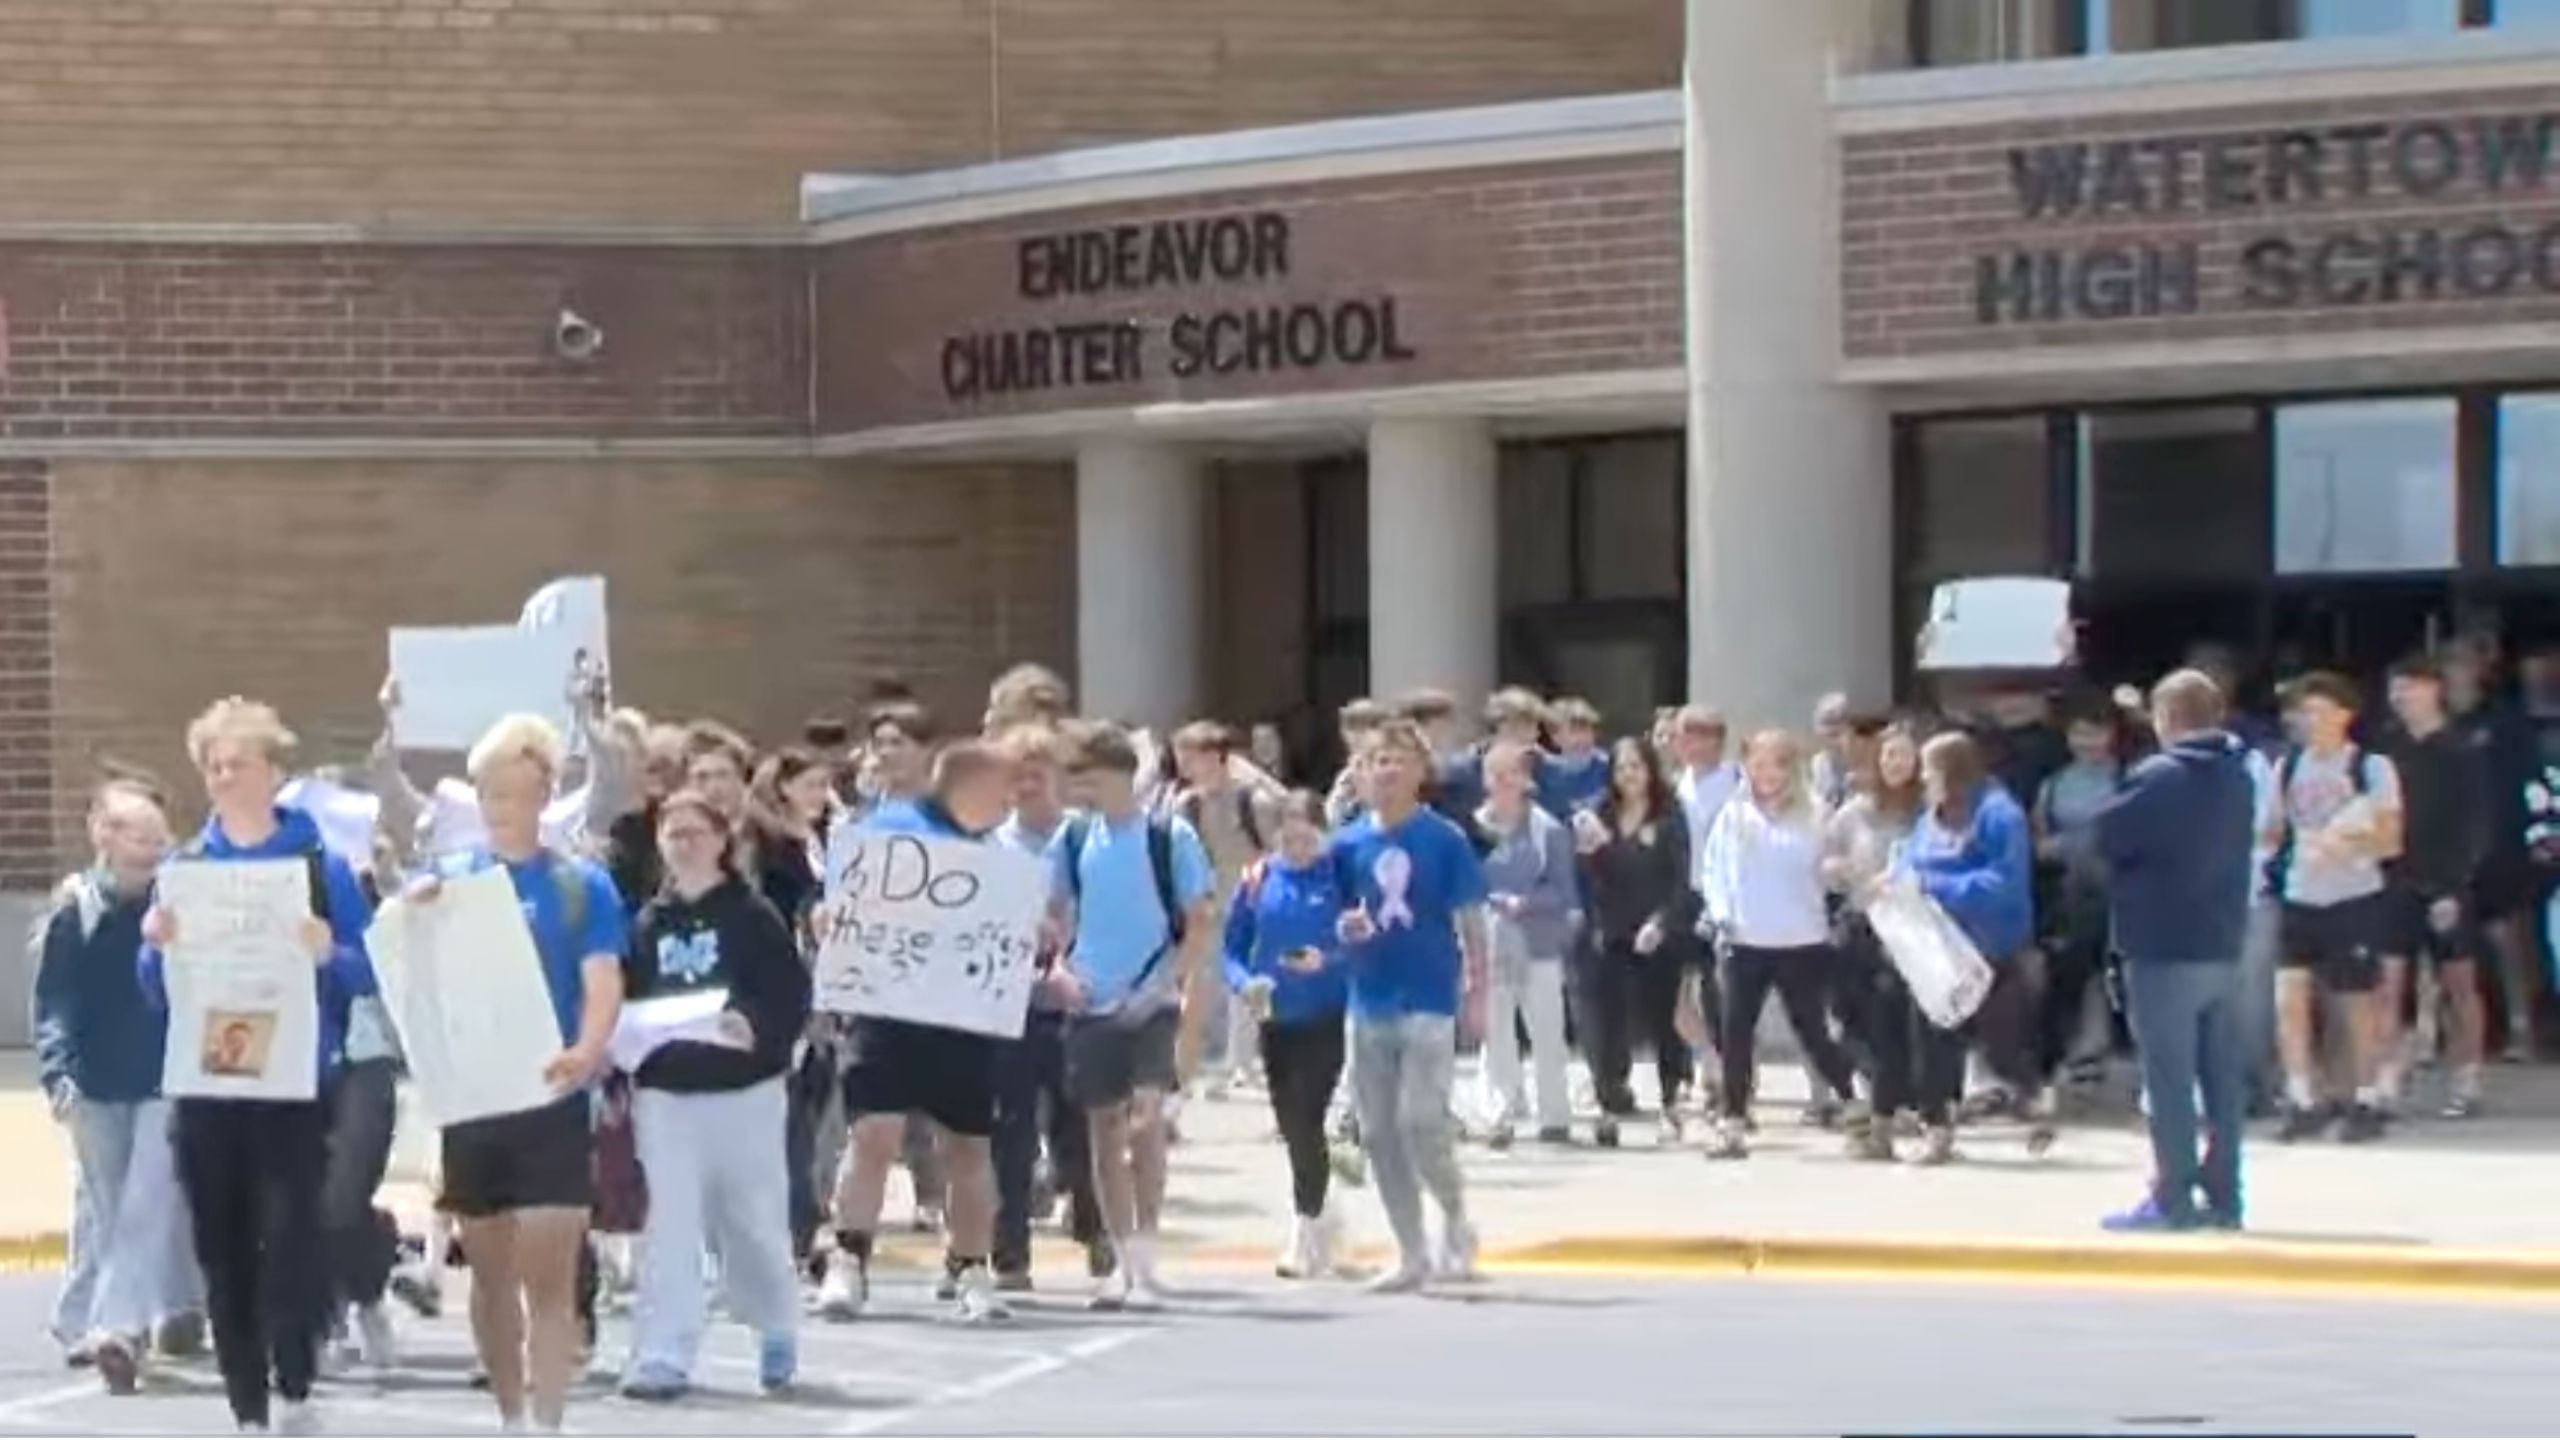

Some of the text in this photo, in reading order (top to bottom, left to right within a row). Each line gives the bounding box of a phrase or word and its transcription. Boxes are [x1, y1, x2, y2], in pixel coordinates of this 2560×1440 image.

[1018, 212, 1289, 299] ENDEAVOR
[1976, 243, 2198, 323] HIGH
[941, 296, 1416, 398] CHARTER SCHOOL
[881, 834, 980, 909] Do
